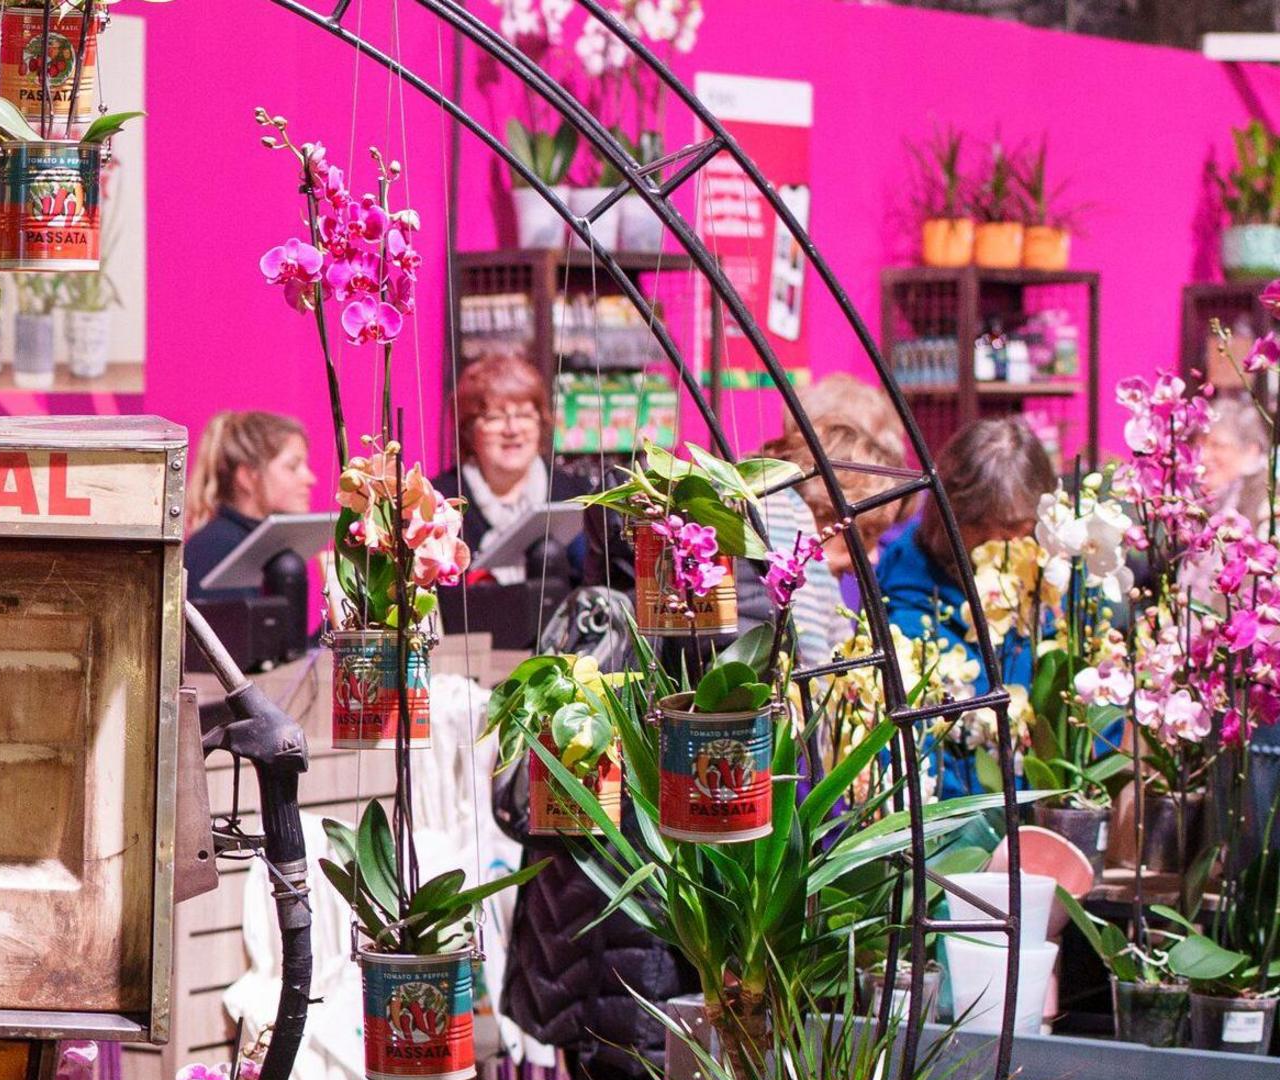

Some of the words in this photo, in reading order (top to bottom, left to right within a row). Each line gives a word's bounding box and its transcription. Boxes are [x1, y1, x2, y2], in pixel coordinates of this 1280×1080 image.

[26, 231, 88, 245] PASSATA
[690, 803, 757, 817] PASSATA
[386, 1045, 452, 1059] PASSATA
